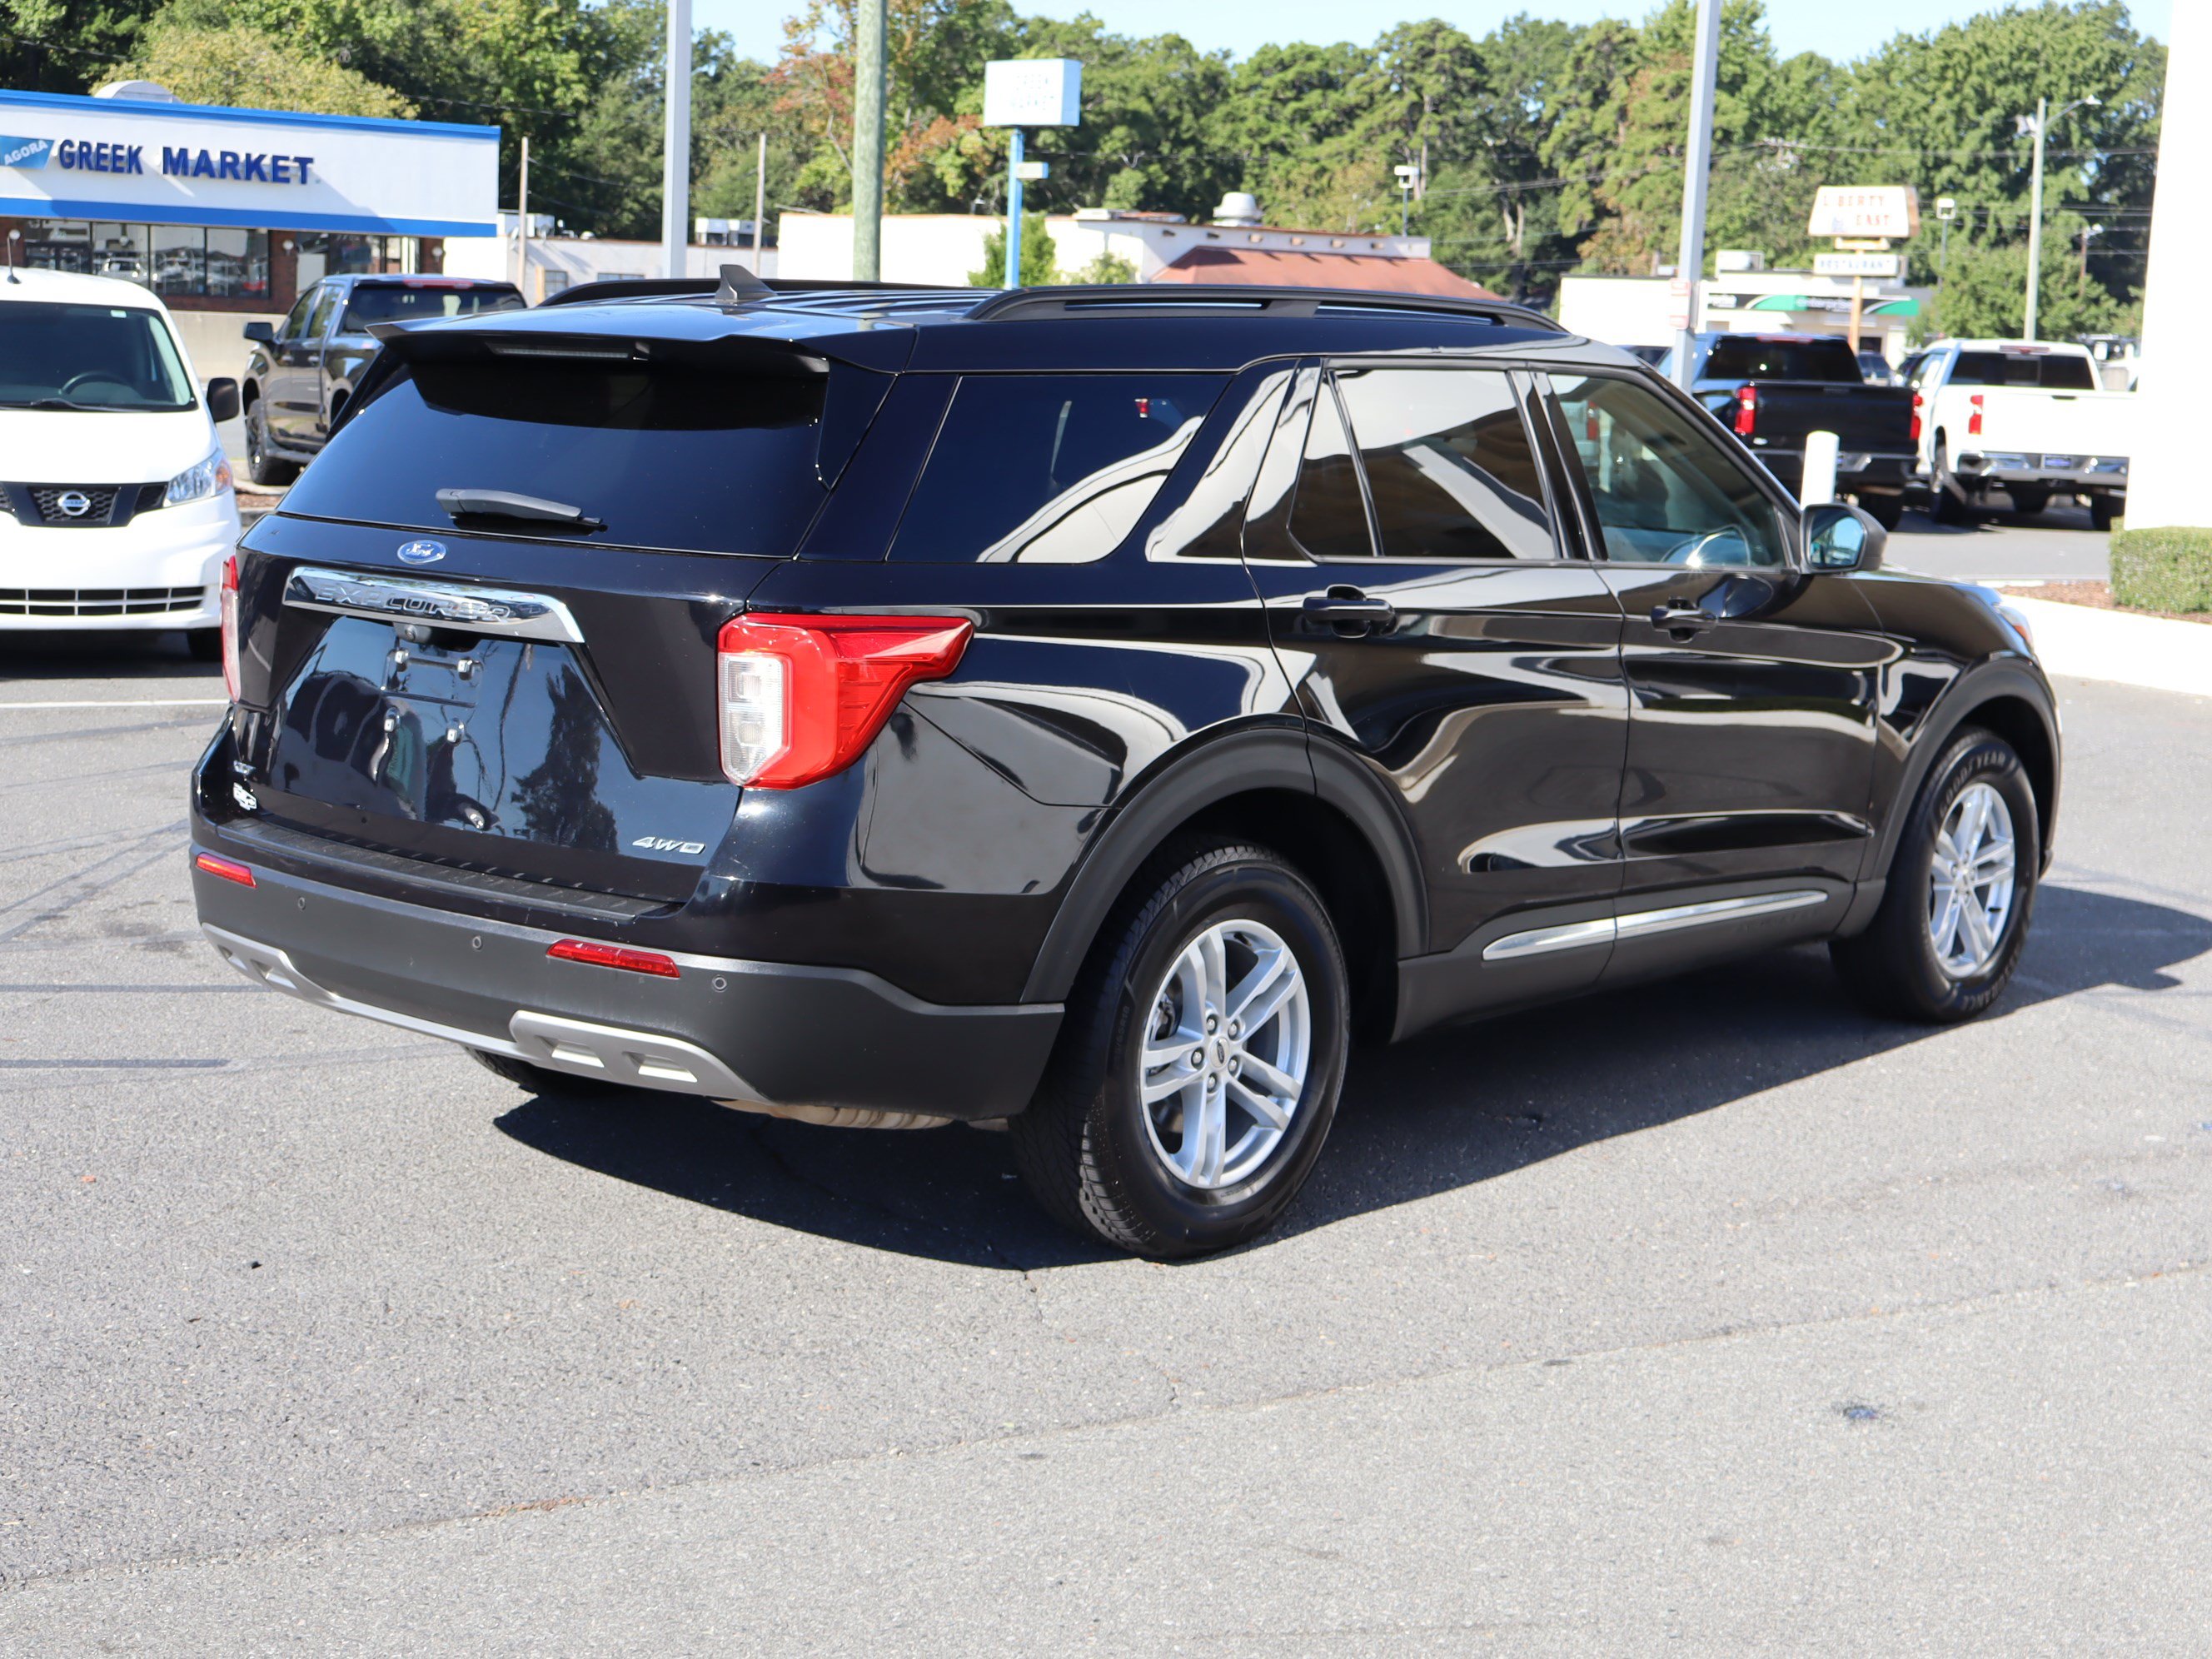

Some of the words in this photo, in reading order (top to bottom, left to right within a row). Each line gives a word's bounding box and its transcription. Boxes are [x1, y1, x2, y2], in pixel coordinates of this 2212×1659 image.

[3, 139, 49, 167] AGORA
[58, 139, 144, 175] GREEK
[162, 146, 315, 185] MARKET
[1823, 195, 1886, 207] LBERTY
[1820, 260, 1891, 269] RESARAN
[315, 586, 511, 623] EXPLORER
[1939, 748, 2007, 820] GOODYEAR
[632, 836, 705, 854] 4WD
